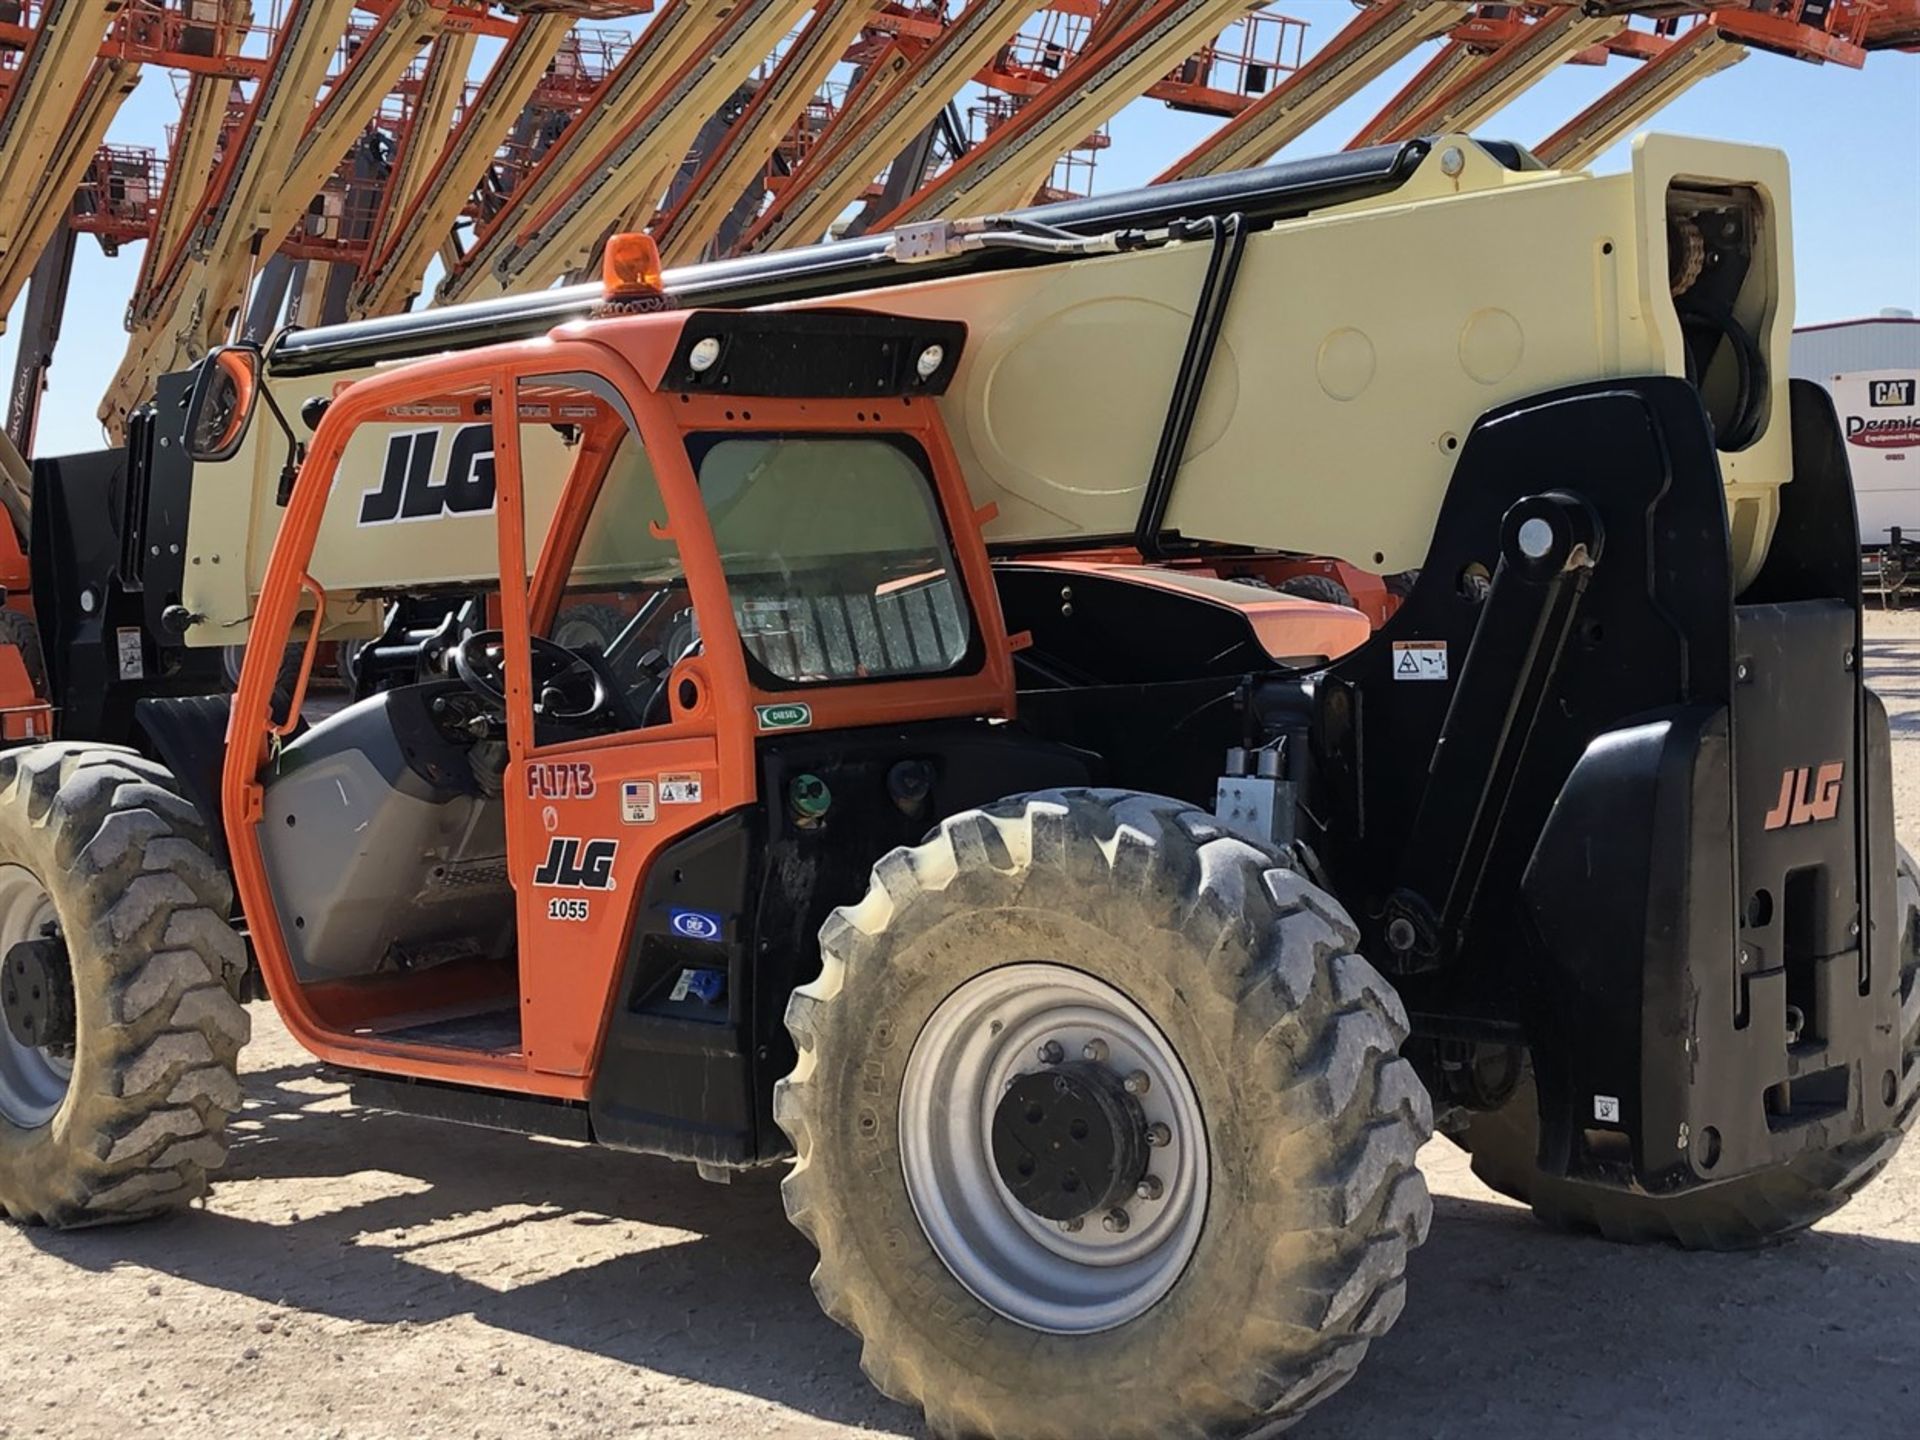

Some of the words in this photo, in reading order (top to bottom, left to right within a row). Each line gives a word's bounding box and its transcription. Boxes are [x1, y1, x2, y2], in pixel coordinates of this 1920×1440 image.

[11, 366, 30, 440] SKYJACK
[1875, 382, 1909, 405] CAT
[360, 424, 496, 523] JLG
[772, 710, 798, 720] DIESEL
[527, 764, 594, 797] FL1713
[1764, 762, 1843, 830] JLG
[535, 839, 617, 888] JLG
[550, 900, 587, 919] 1055
